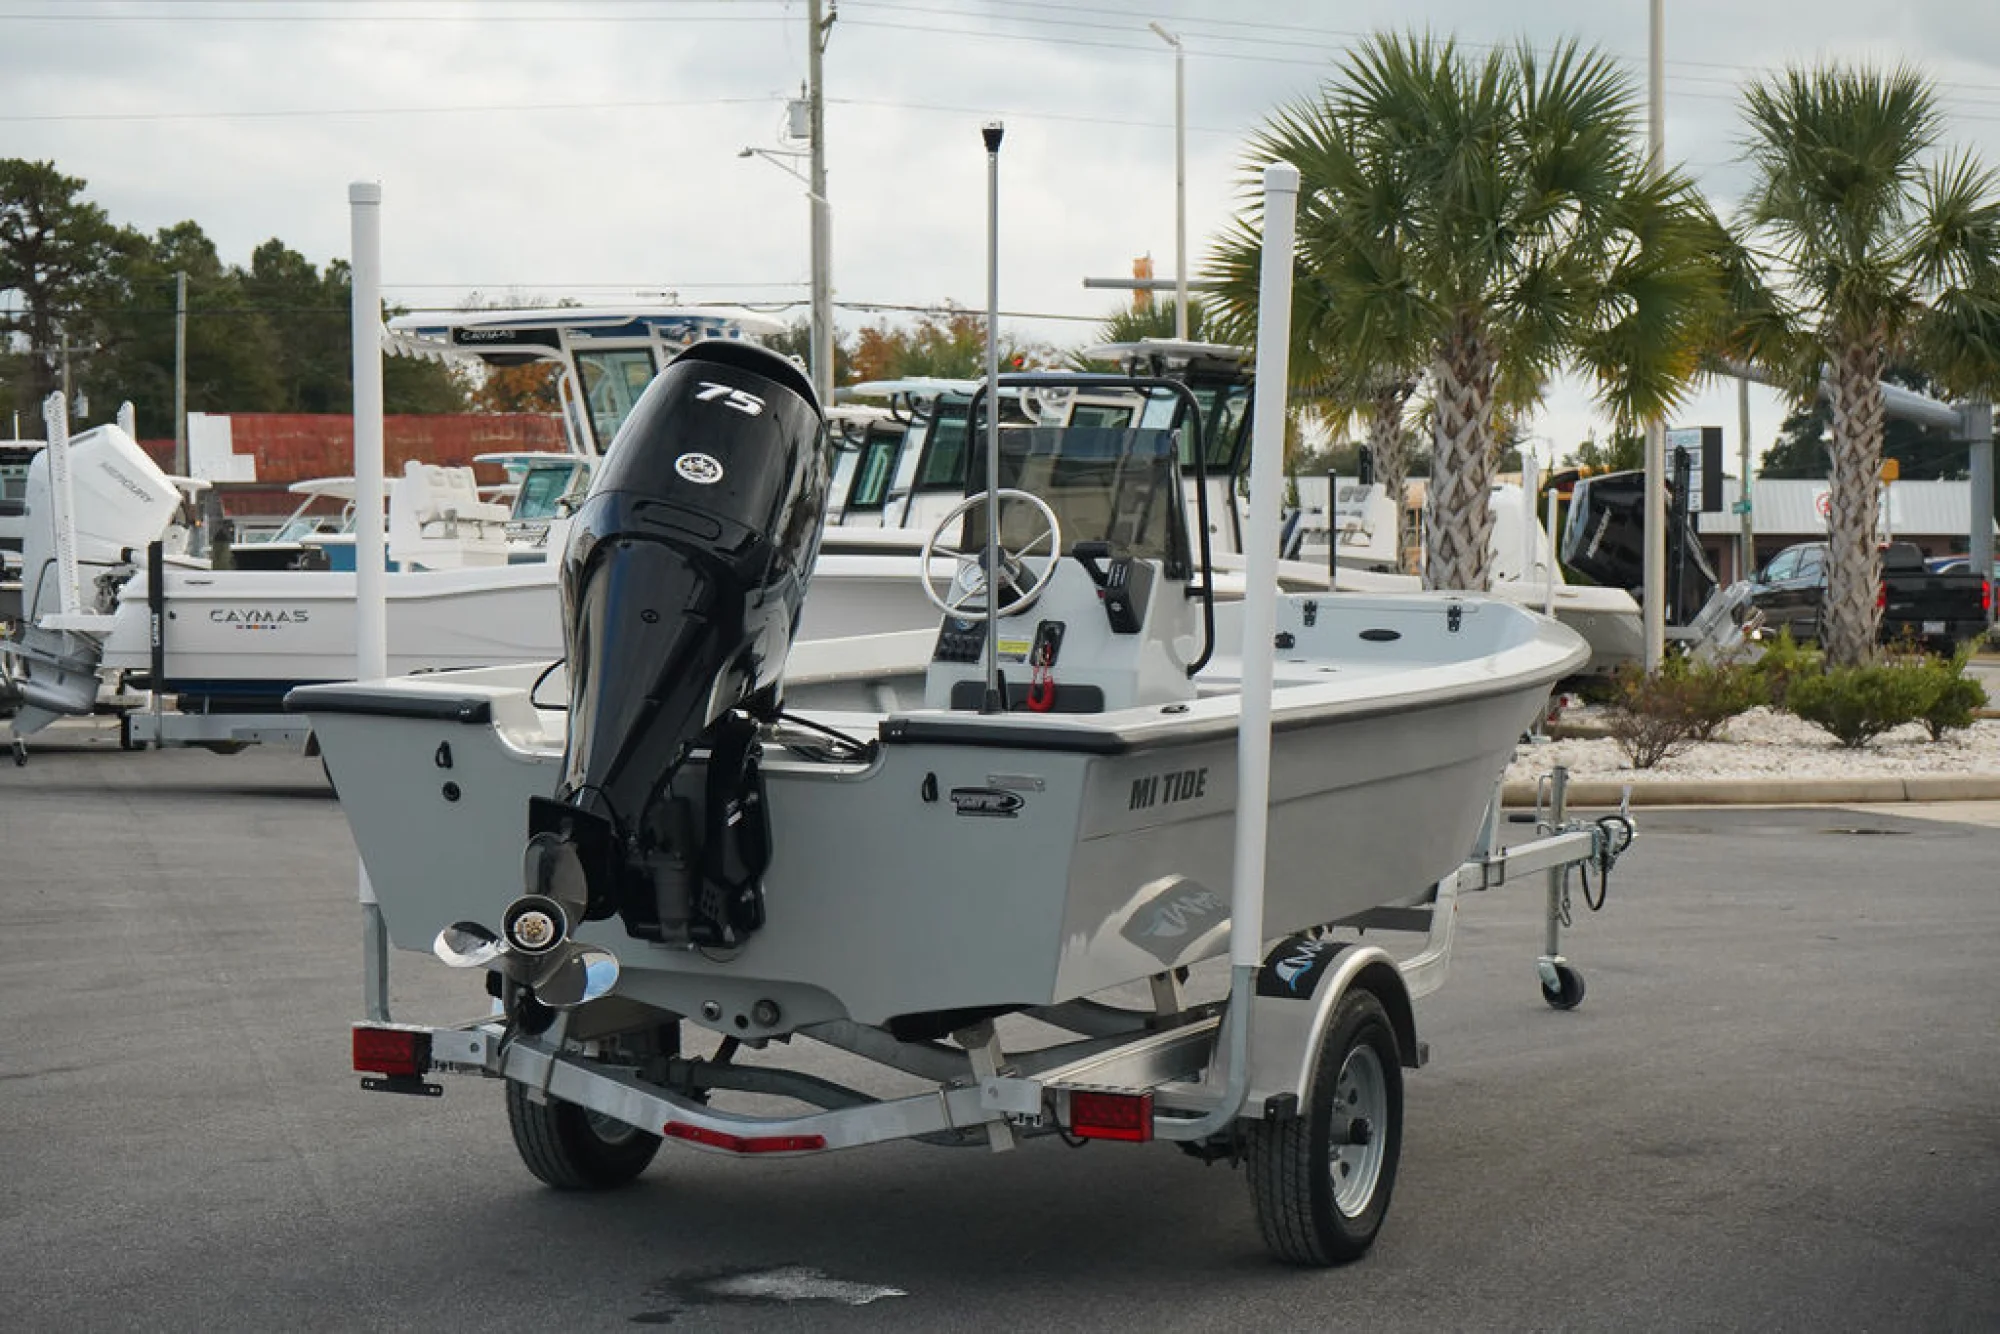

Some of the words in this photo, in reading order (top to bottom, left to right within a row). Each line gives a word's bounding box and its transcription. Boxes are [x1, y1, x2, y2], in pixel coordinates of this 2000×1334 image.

[695, 382, 766, 416] 75
[210, 608, 309, 622] CAYMAS
[1128, 774, 1159, 812] MI
[1162, 766, 1208, 805] TIDE
